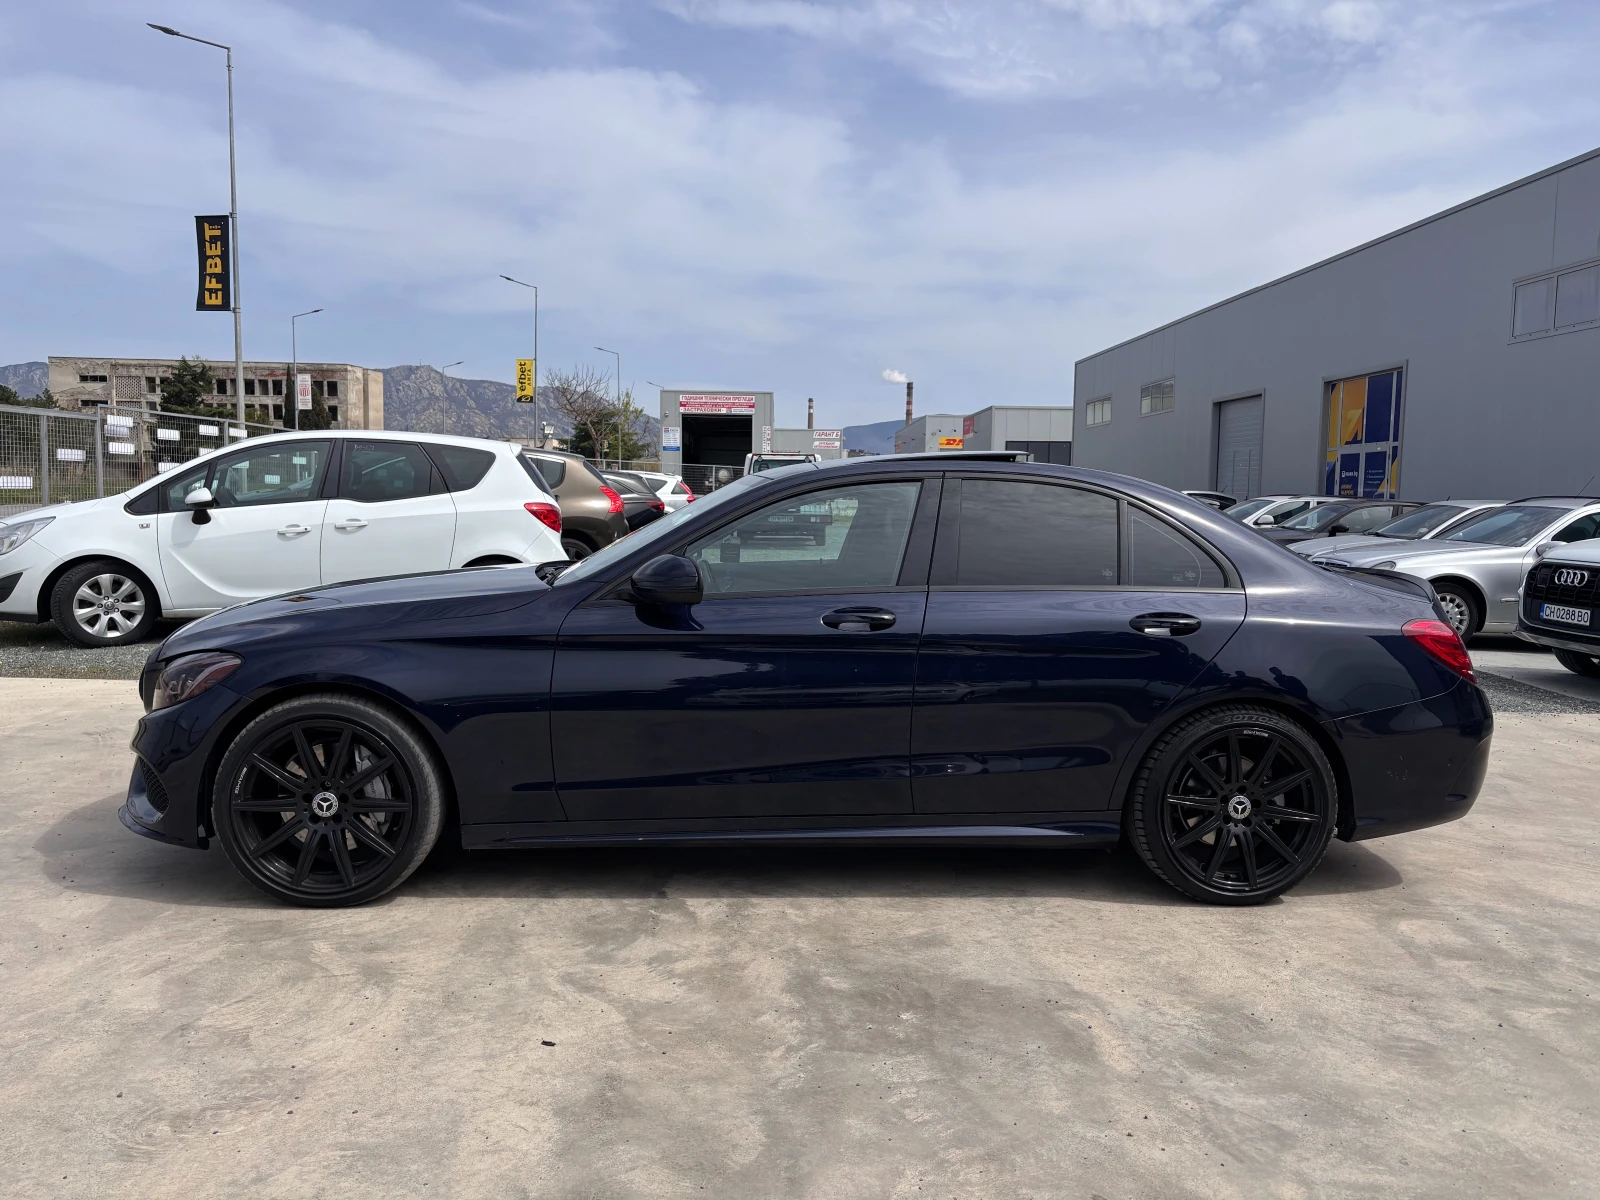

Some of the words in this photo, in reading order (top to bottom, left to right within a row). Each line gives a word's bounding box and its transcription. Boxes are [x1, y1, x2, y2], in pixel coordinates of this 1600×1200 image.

[204, 222, 223, 305] EFBET
[518, 361, 527, 392] efbet
[1556, 607, 1576, 621] 0288
